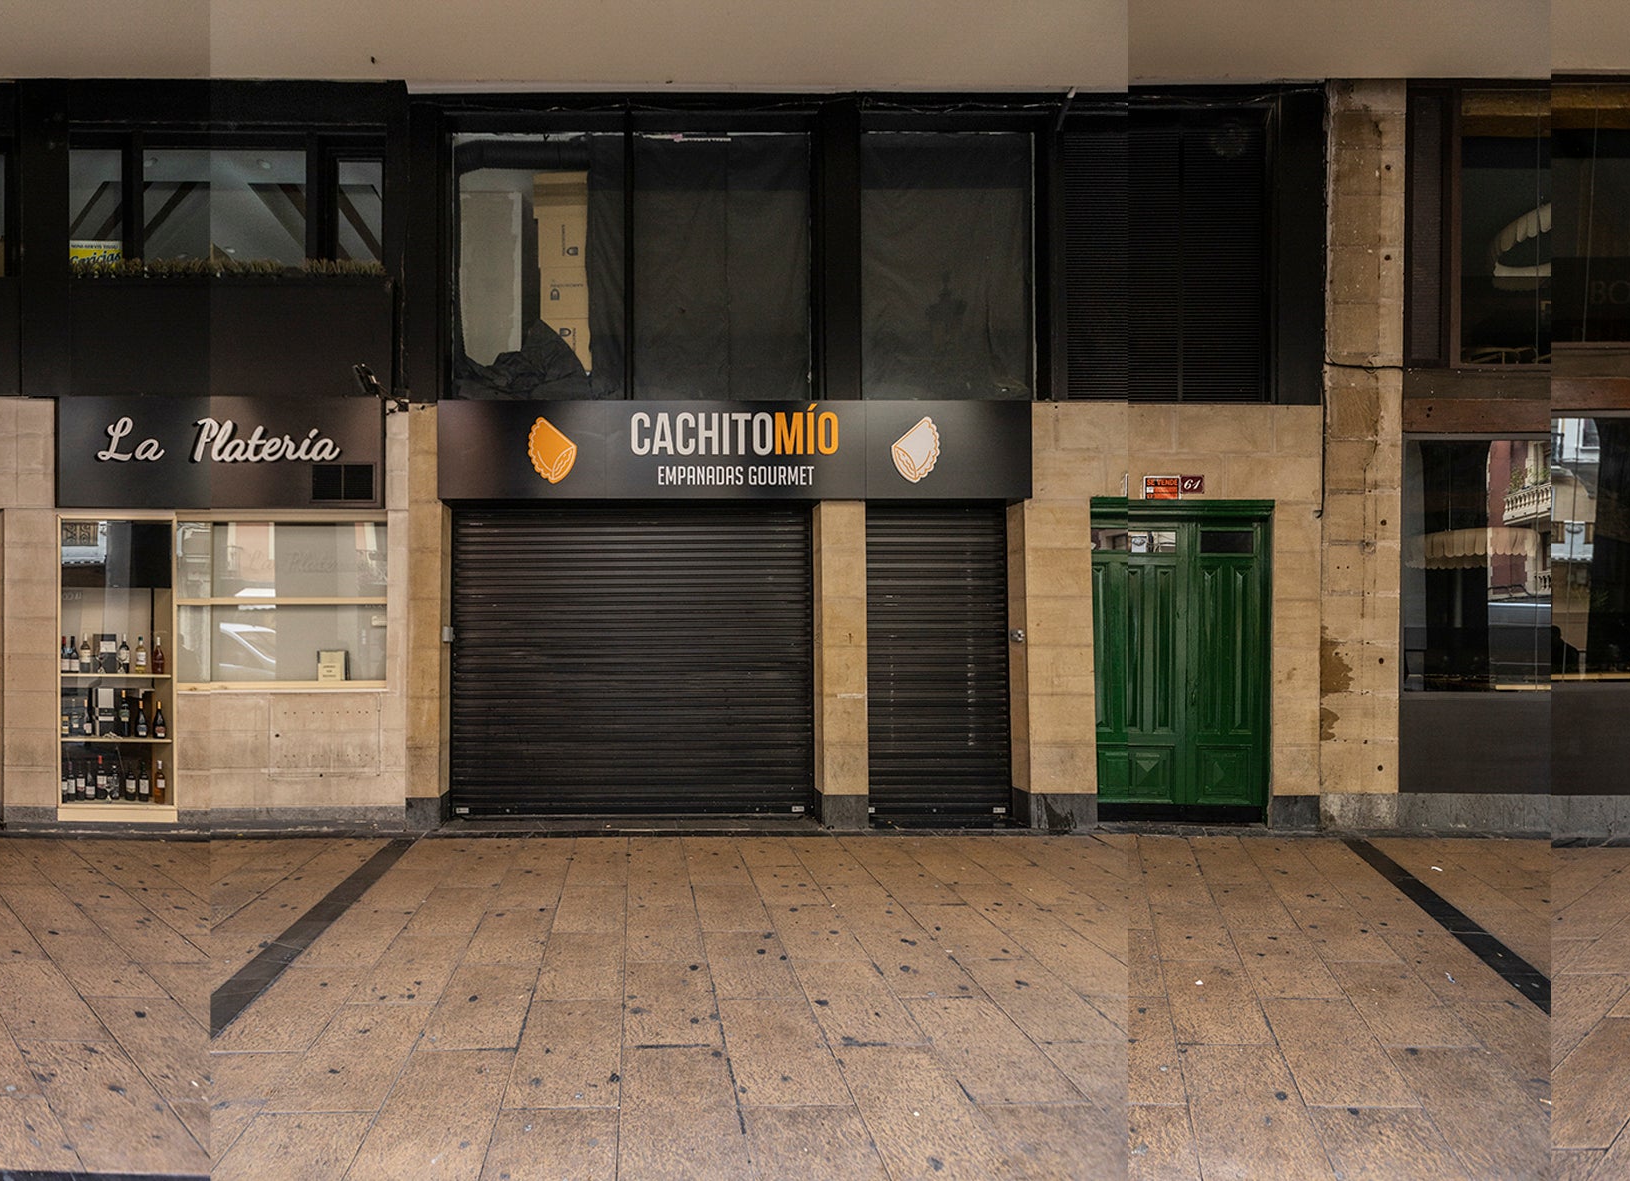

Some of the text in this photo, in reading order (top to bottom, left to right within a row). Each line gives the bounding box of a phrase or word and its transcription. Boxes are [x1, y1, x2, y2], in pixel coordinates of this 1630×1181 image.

[95, 416, 340, 463] La Platería
[630, 403, 839, 456] CACHITOMÍO
[657, 465, 815, 486] EMPANADAS GOURMET
[1156, 478, 1178, 486] VENDE
[1183, 479, 1201, 490] 61
